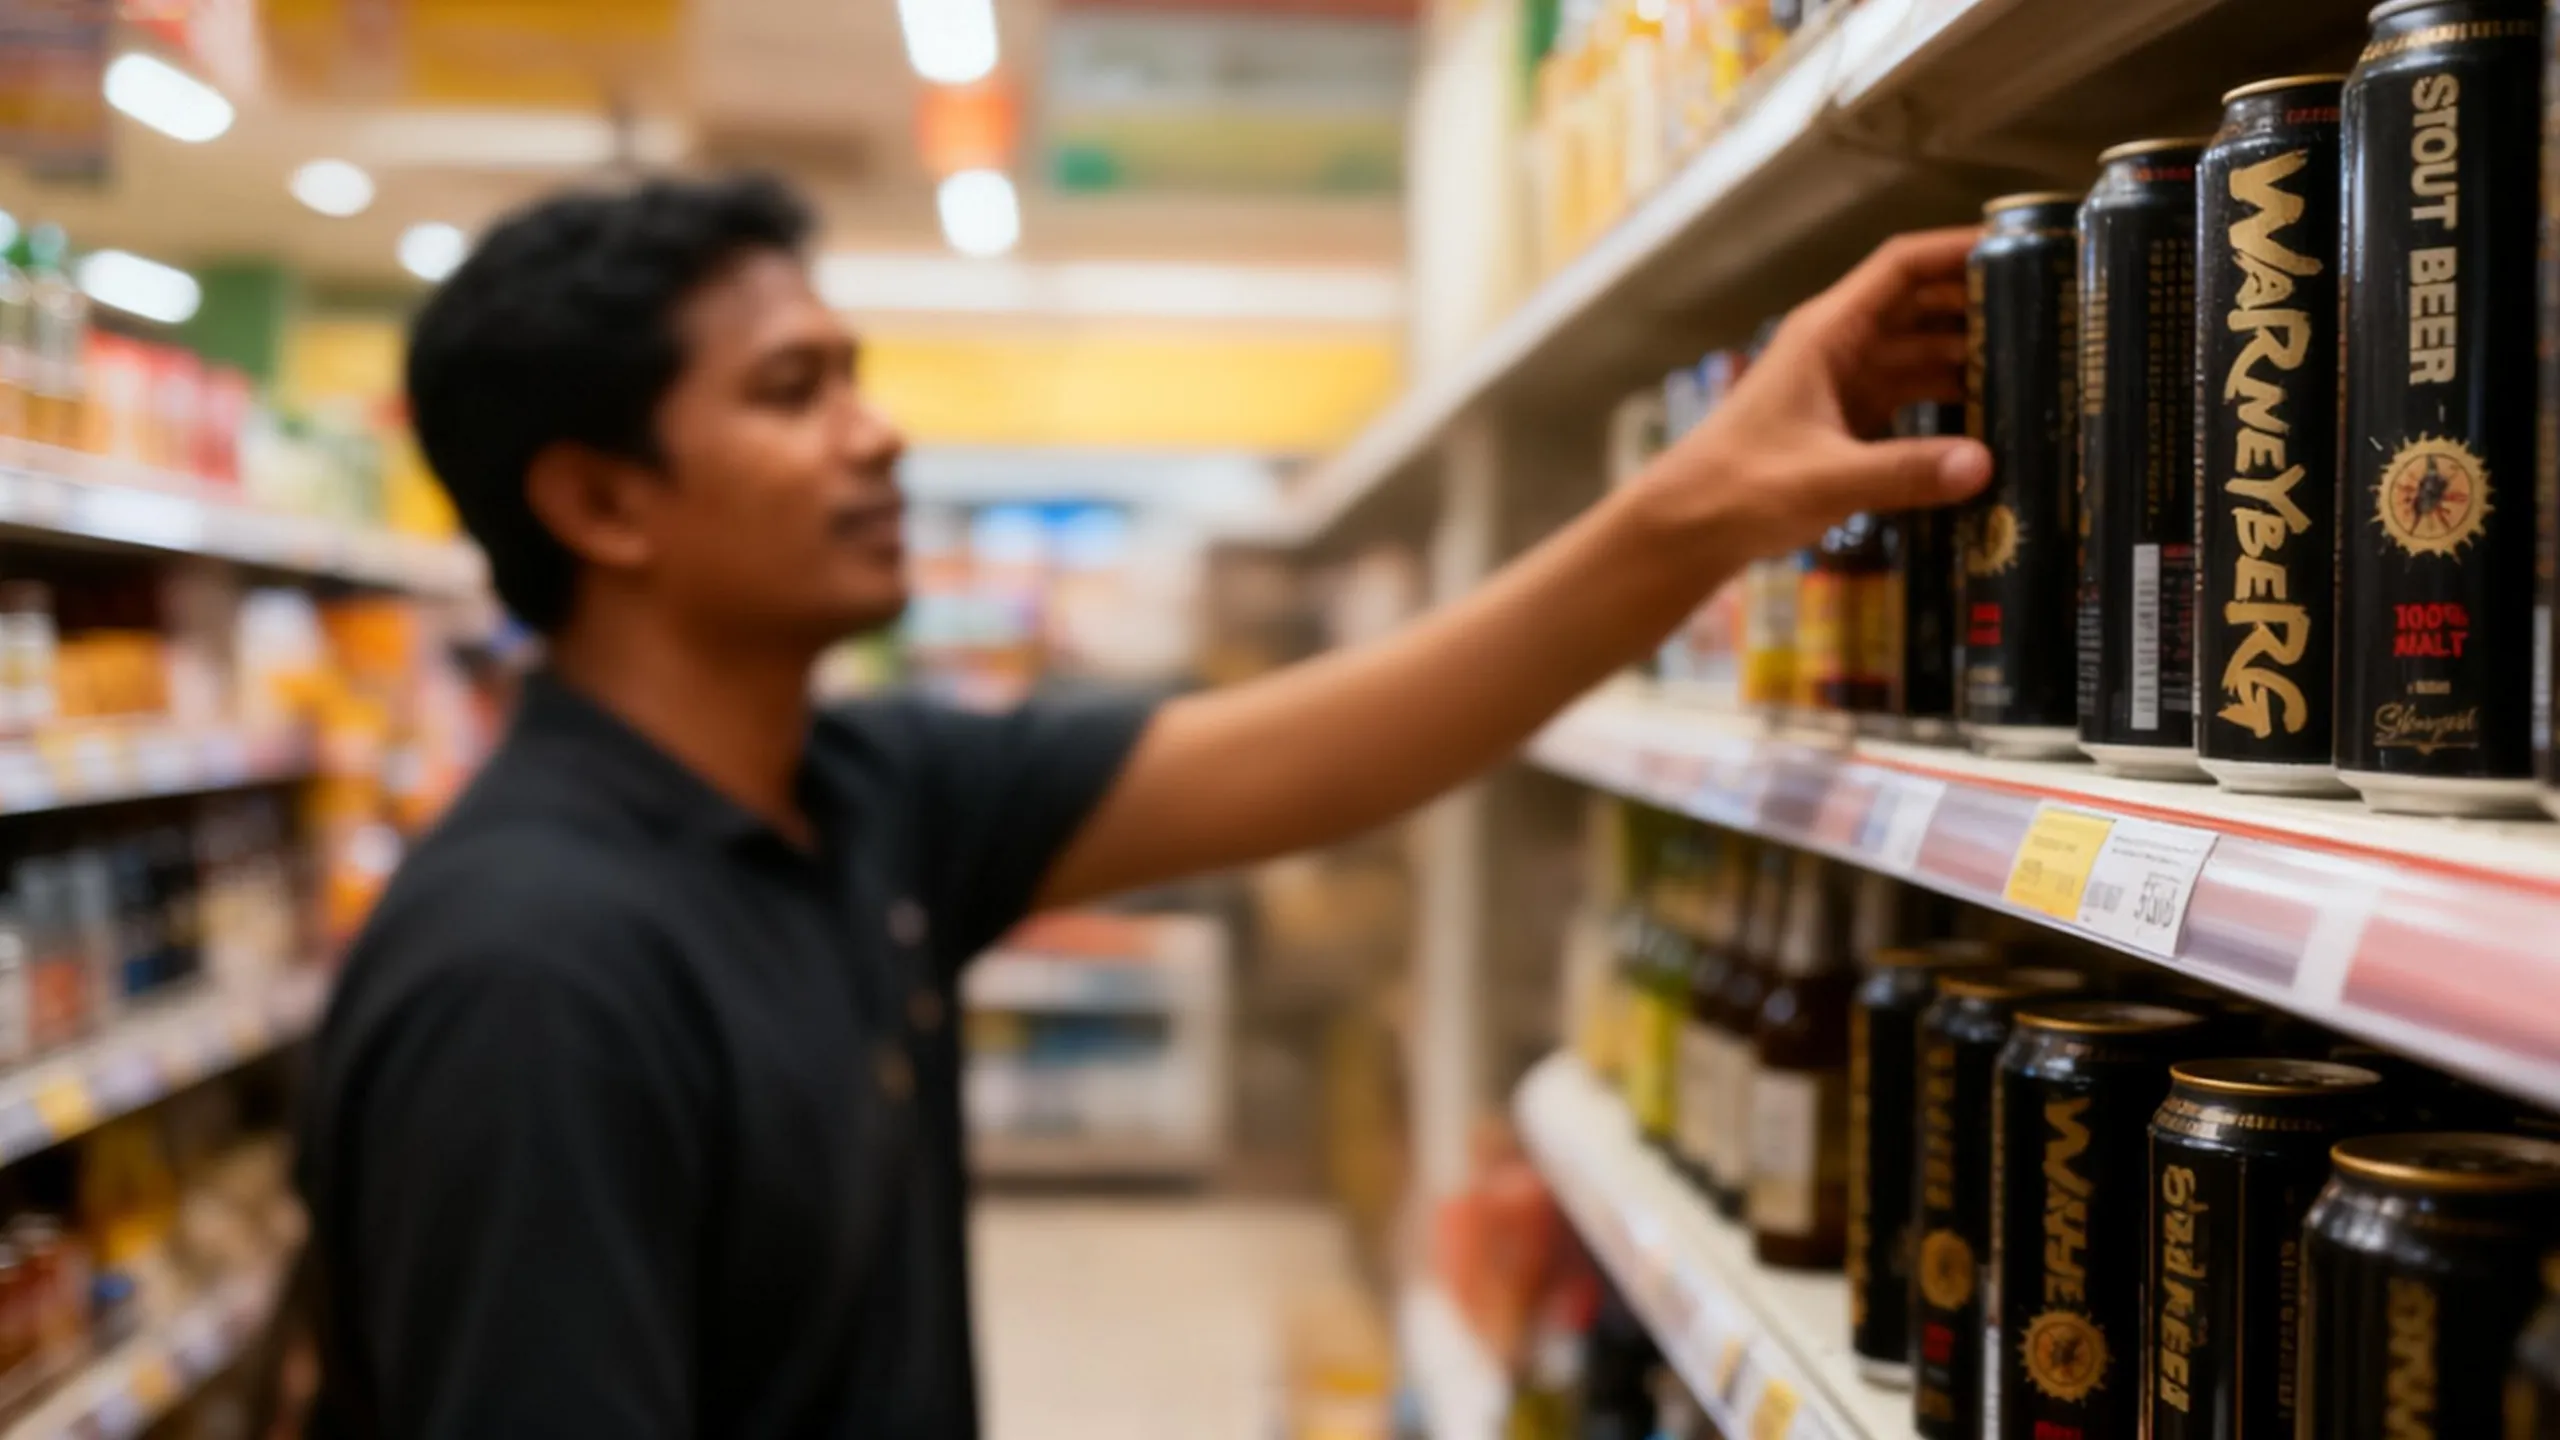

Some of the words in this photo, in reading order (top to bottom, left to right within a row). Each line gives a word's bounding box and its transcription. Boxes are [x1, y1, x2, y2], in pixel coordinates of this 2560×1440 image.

[2411, 73, 2459, 229] STOUT
[2409, 247, 2458, 385] BEER
[2217, 149, 2323, 738] WARNEYBERG
[2394, 630, 2469, 658] MALT
